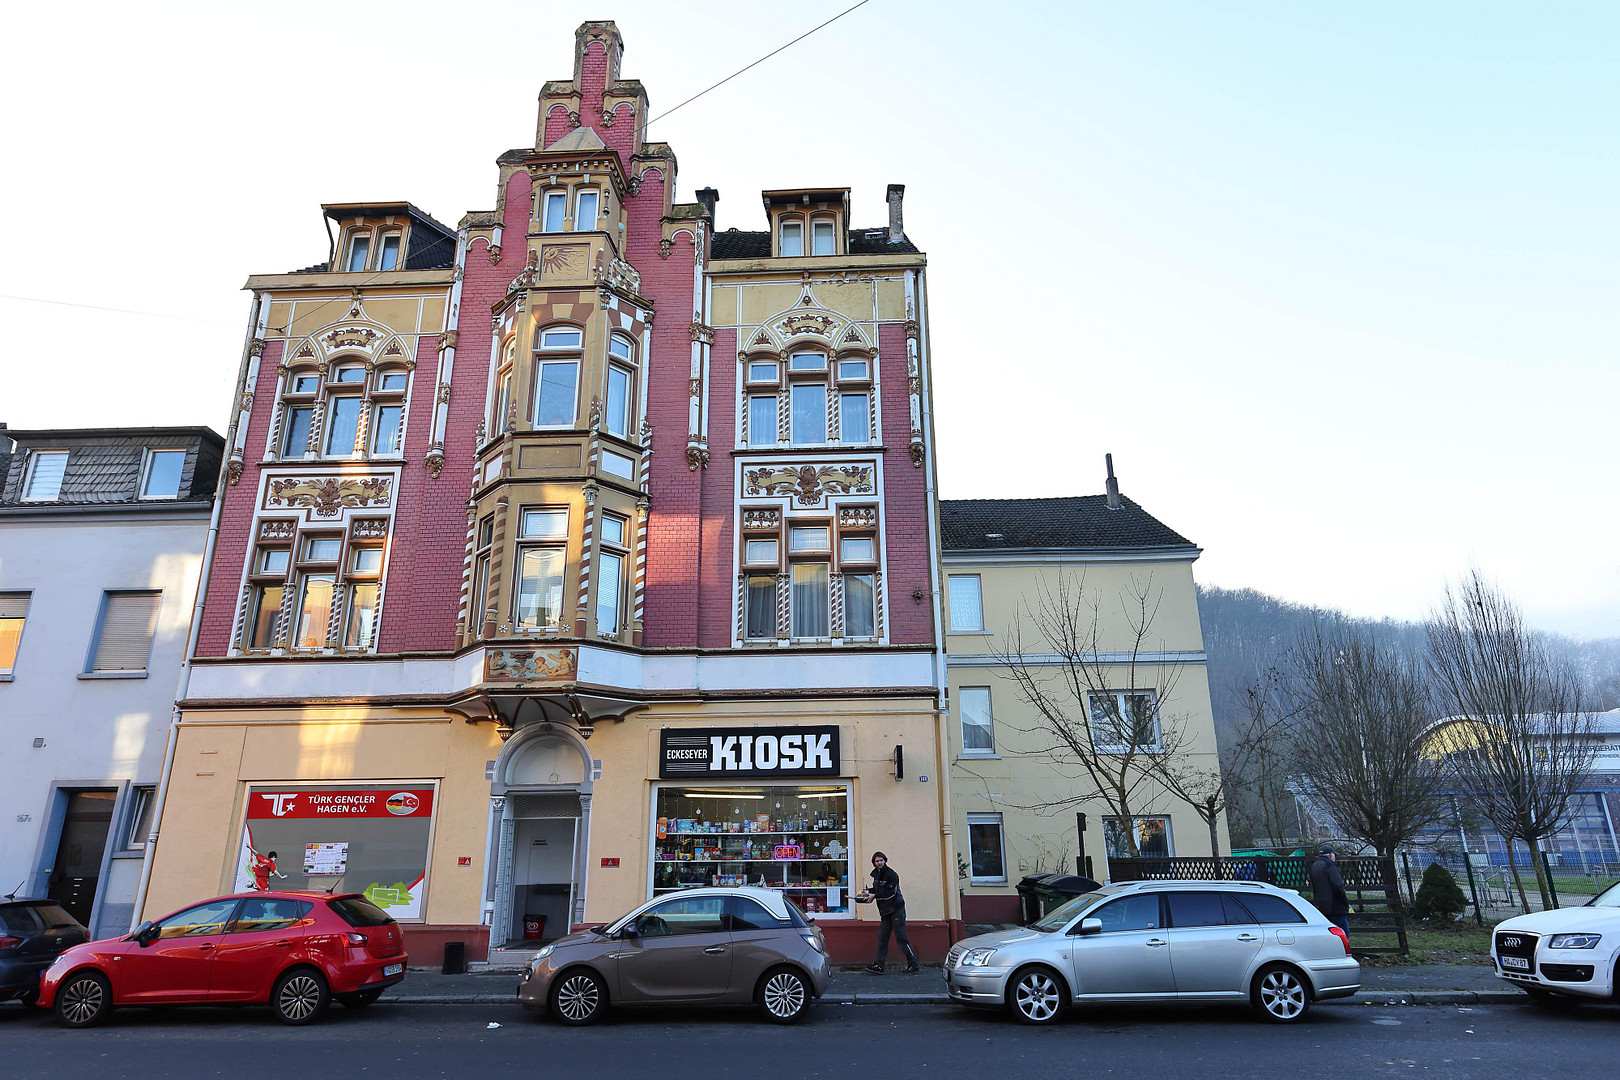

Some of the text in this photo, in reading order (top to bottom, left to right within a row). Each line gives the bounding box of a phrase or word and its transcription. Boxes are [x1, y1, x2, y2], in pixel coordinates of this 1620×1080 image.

[666, 749, 708, 760] ECKESEYER
[710, 733, 833, 771] KIOSK
[308, 795, 376, 805] TÜRK GENÇLER
[316, 805, 367, 813] HAGEN e.V.
[776, 847, 799, 858] OPEN
